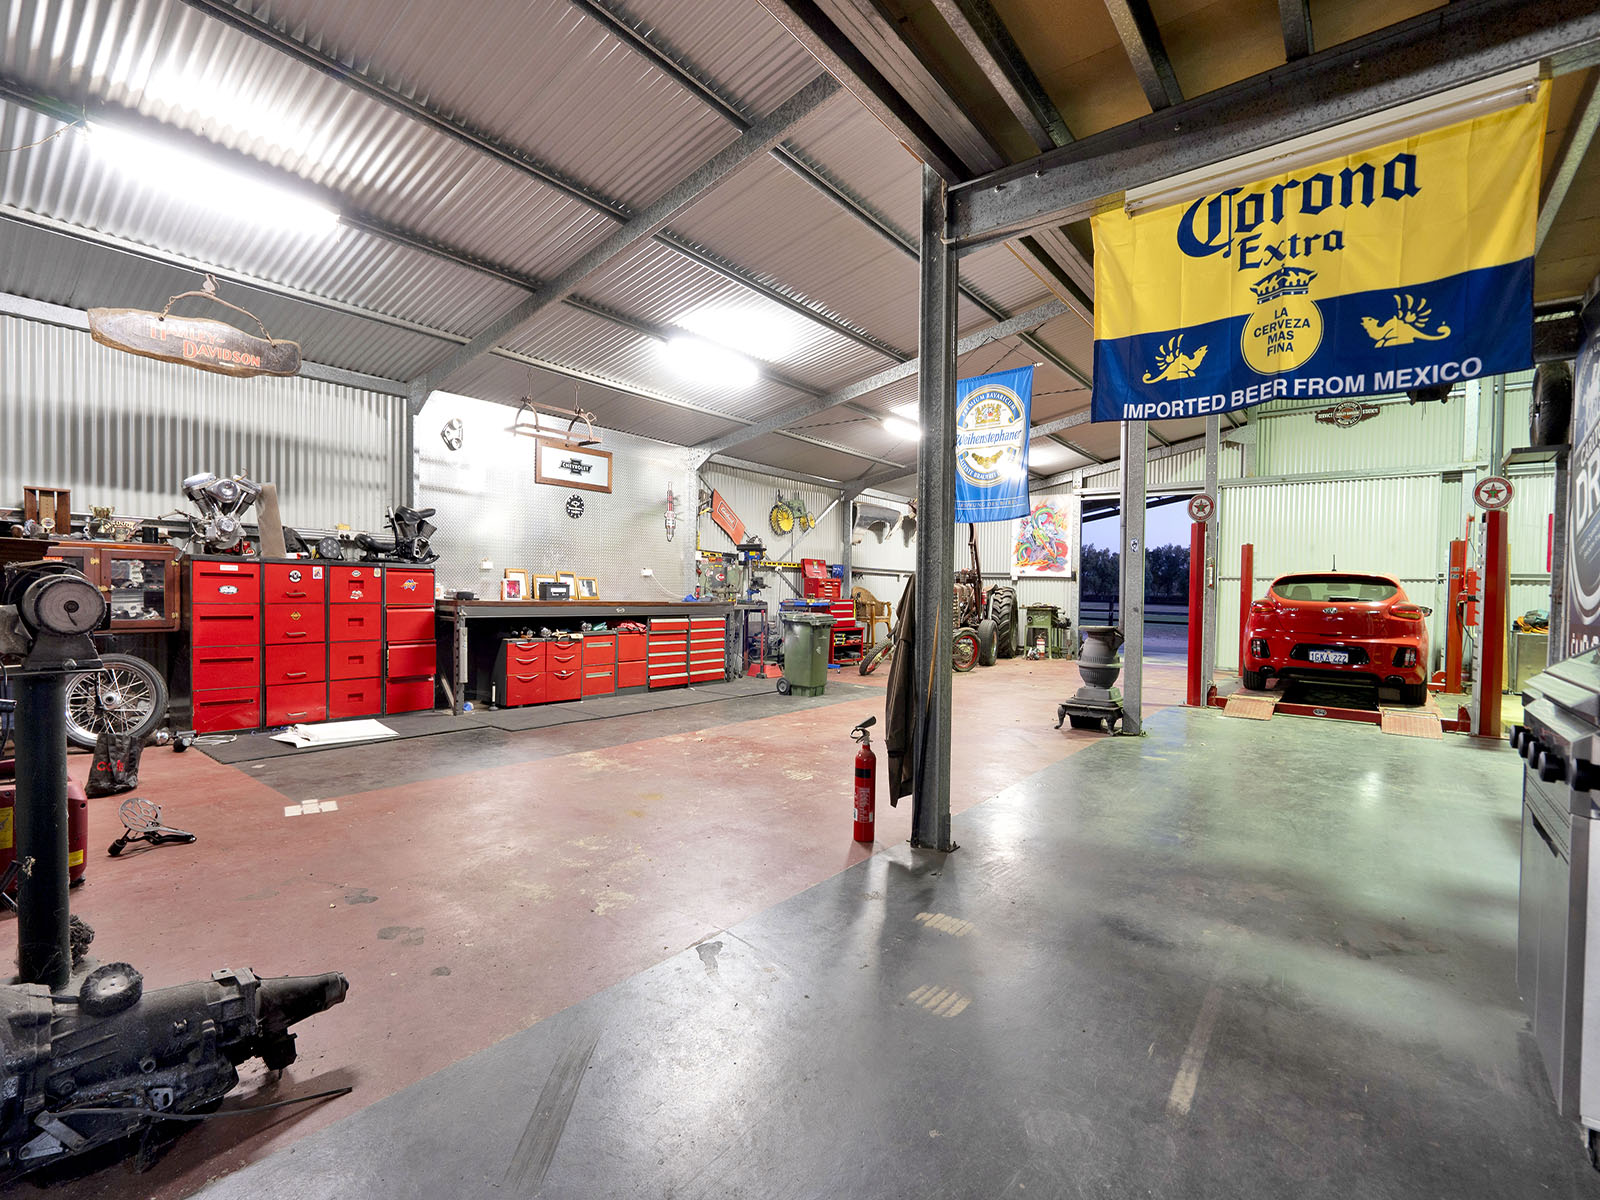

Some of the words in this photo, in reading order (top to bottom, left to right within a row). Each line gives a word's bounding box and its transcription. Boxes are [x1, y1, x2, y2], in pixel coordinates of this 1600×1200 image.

[1177, 153, 1422, 259] Corona
[1238, 229, 1345, 272] Extra
[1274, 306, 1289, 320] LA
[1253, 317, 1311, 338] CERVEZA
[1267, 330, 1294, 345] MAS
[183, 341, 261, 368] DAVIDSON
[1266, 342, 1294, 357] FINA
[1122, 394, 1226, 420] IMPORTED
[1231, 378, 1287, 406] BEER
[1297, 374, 1366, 396] FROM
[1373, 356, 1482, 391] MEXICO
[961, 393, 985, 417] PREMIUM
[986, 392, 1017, 411] BAVARICUM
[562, 462, 590, 472] CHEVROLET
[1333, 654, 1348, 663] 222
